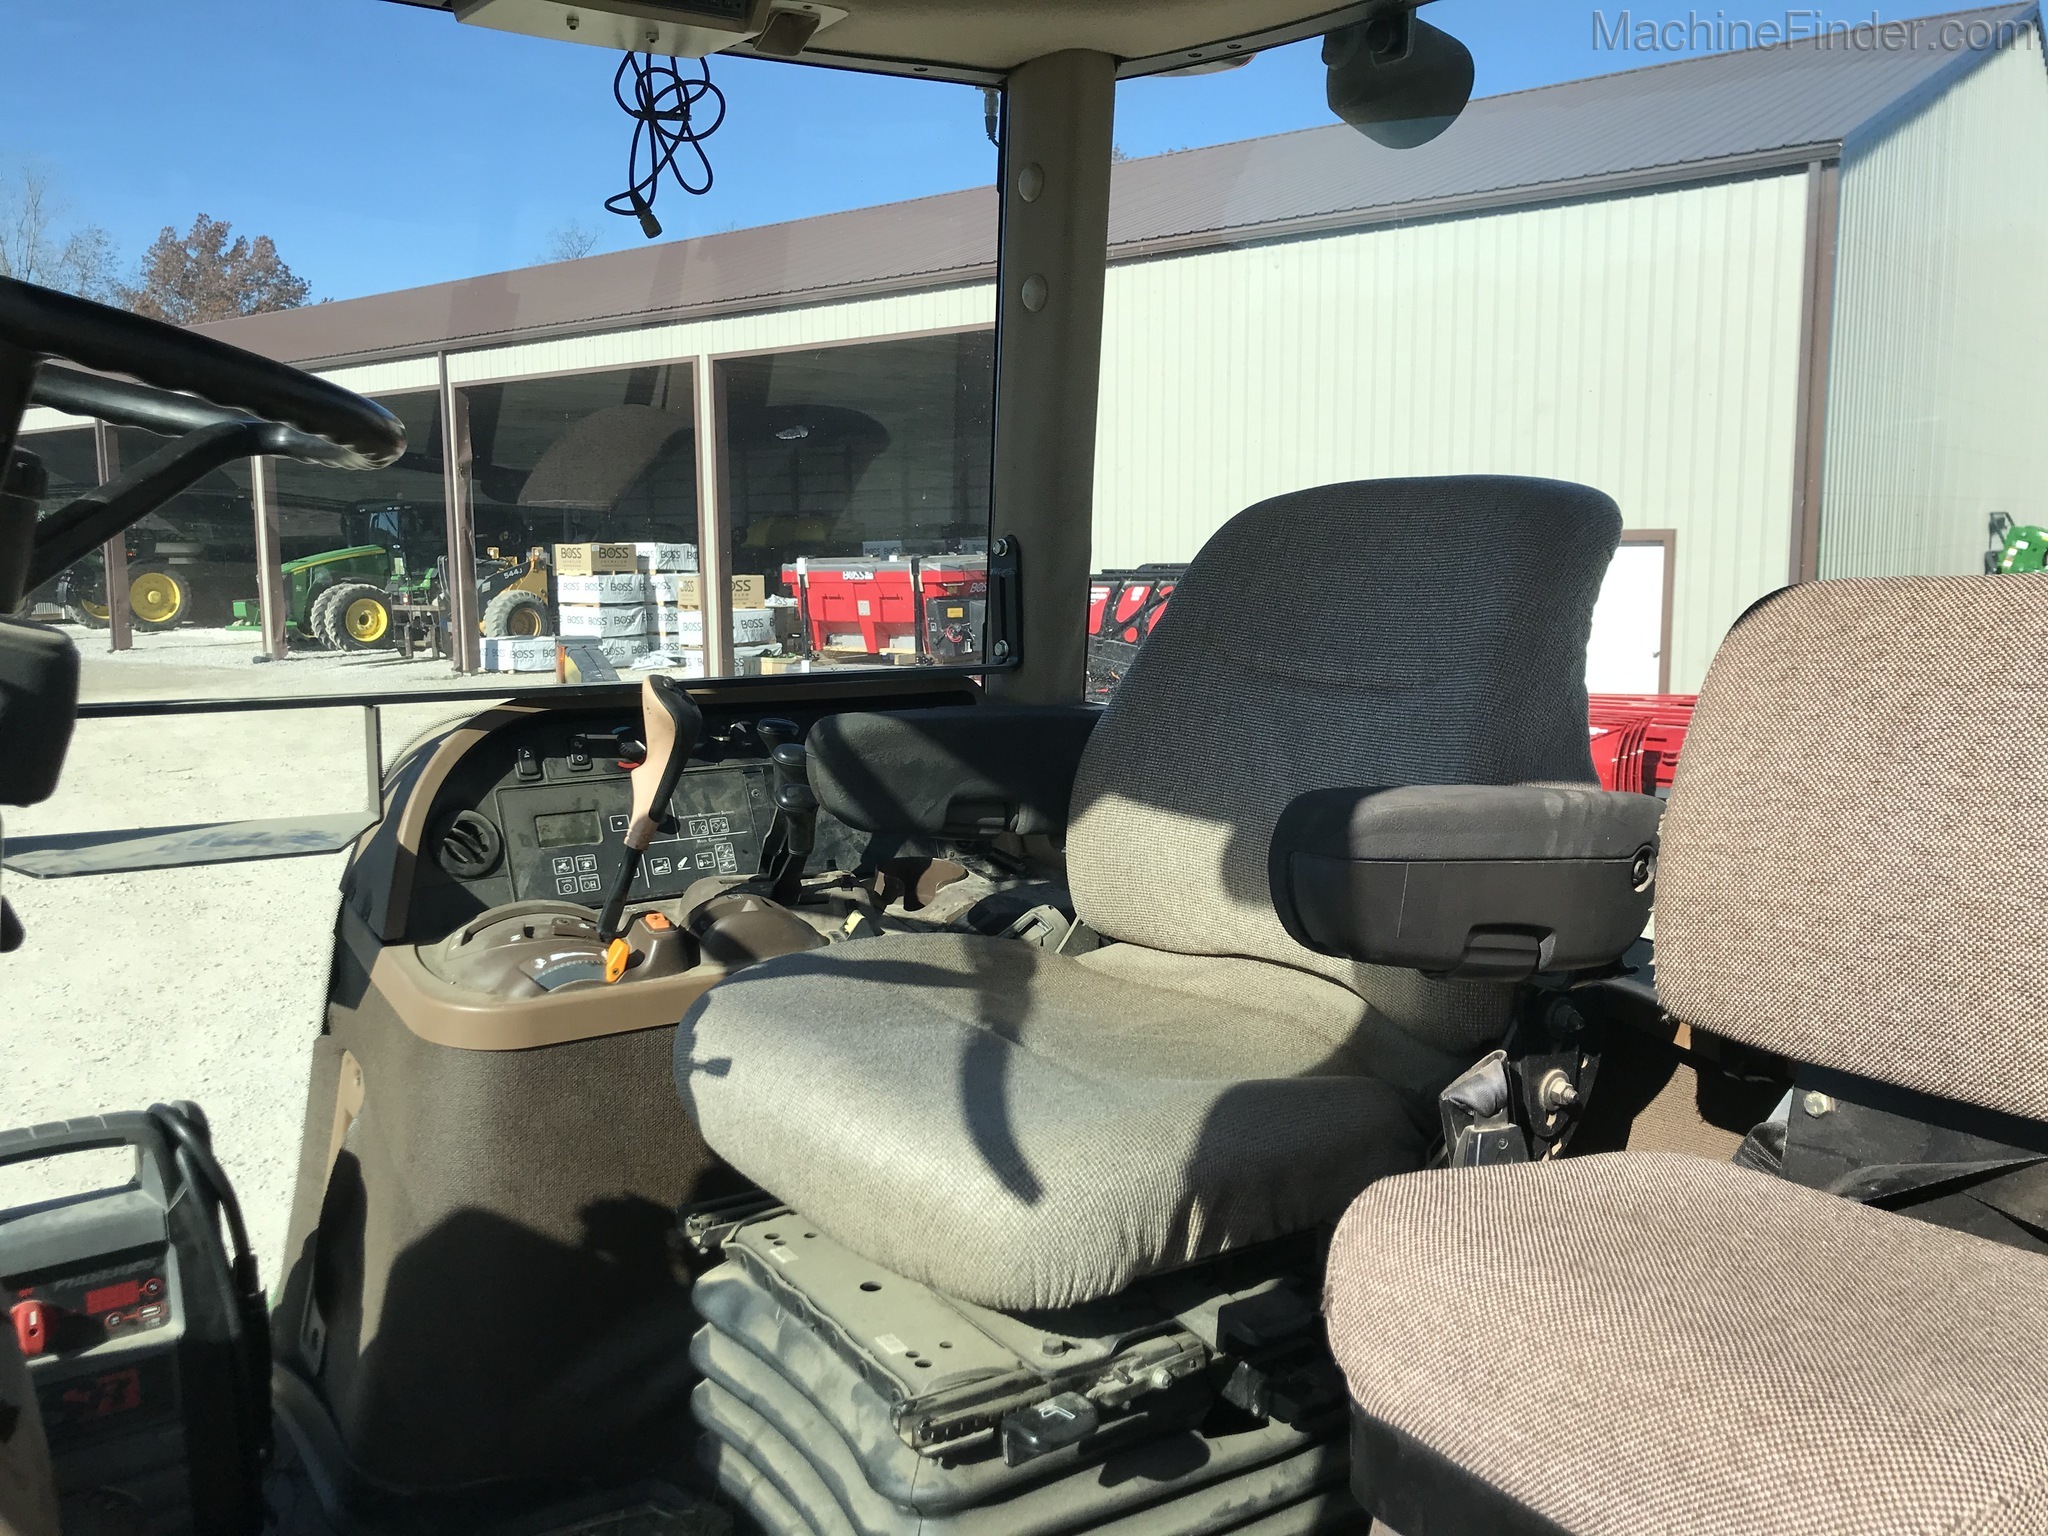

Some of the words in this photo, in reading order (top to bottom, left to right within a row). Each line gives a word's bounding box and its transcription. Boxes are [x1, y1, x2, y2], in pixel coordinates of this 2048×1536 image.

[561, 547, 582, 558] BOSS
[599, 547, 629, 558] BOSS
[504, 568, 523, 579] 544J
[843, 571, 865, 580] BOSS
[585, 583, 604, 591] BOSS
[611, 583, 633, 591] BOSS
[681, 581, 694, 592] OSS
[567, 616, 584, 625] BOSS
[588, 617, 607, 625] BOSS
[614, 615, 636, 625] BOSS
[741, 618, 763, 629] BOSS
[683, 622, 702, 631] BOSS
[510, 649, 535, 659] BOSS
[603, 646, 625, 656] BOSS
